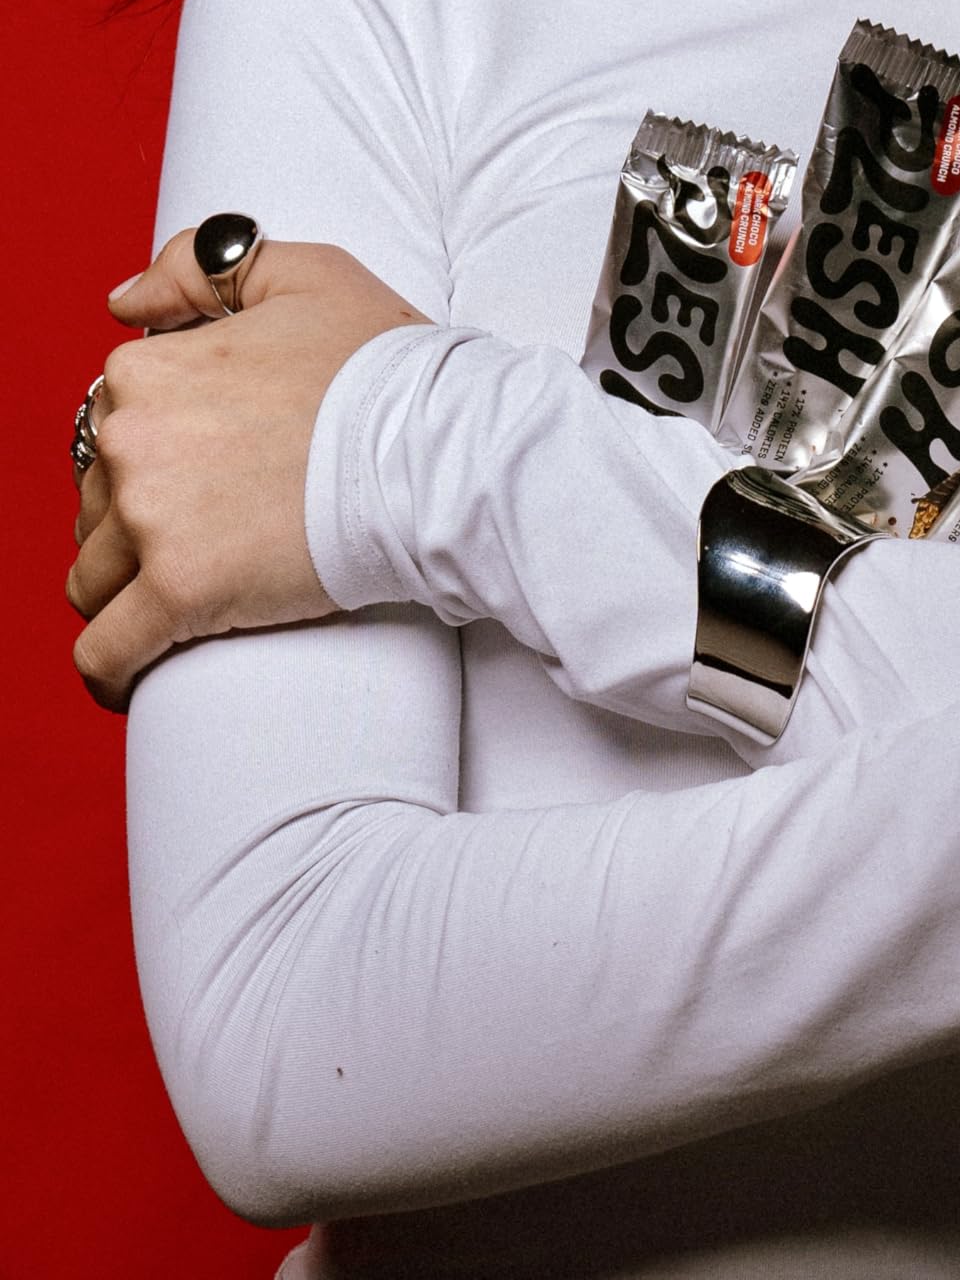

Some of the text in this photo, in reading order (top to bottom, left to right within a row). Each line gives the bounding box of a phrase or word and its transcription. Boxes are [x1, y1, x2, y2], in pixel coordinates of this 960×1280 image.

[937, 104, 960, 183] ALMOND CRUNCH
[735, 215, 750, 254] CRUNCH
[748, 214, 761, 246] CHOCO
[747, 408, 764, 441] ADDED
[758, 389, 790, 459] 142 CALORIES
[774, 398, 805, 462] 17% PROTEIN
[866, 468, 883, 487] 17%
